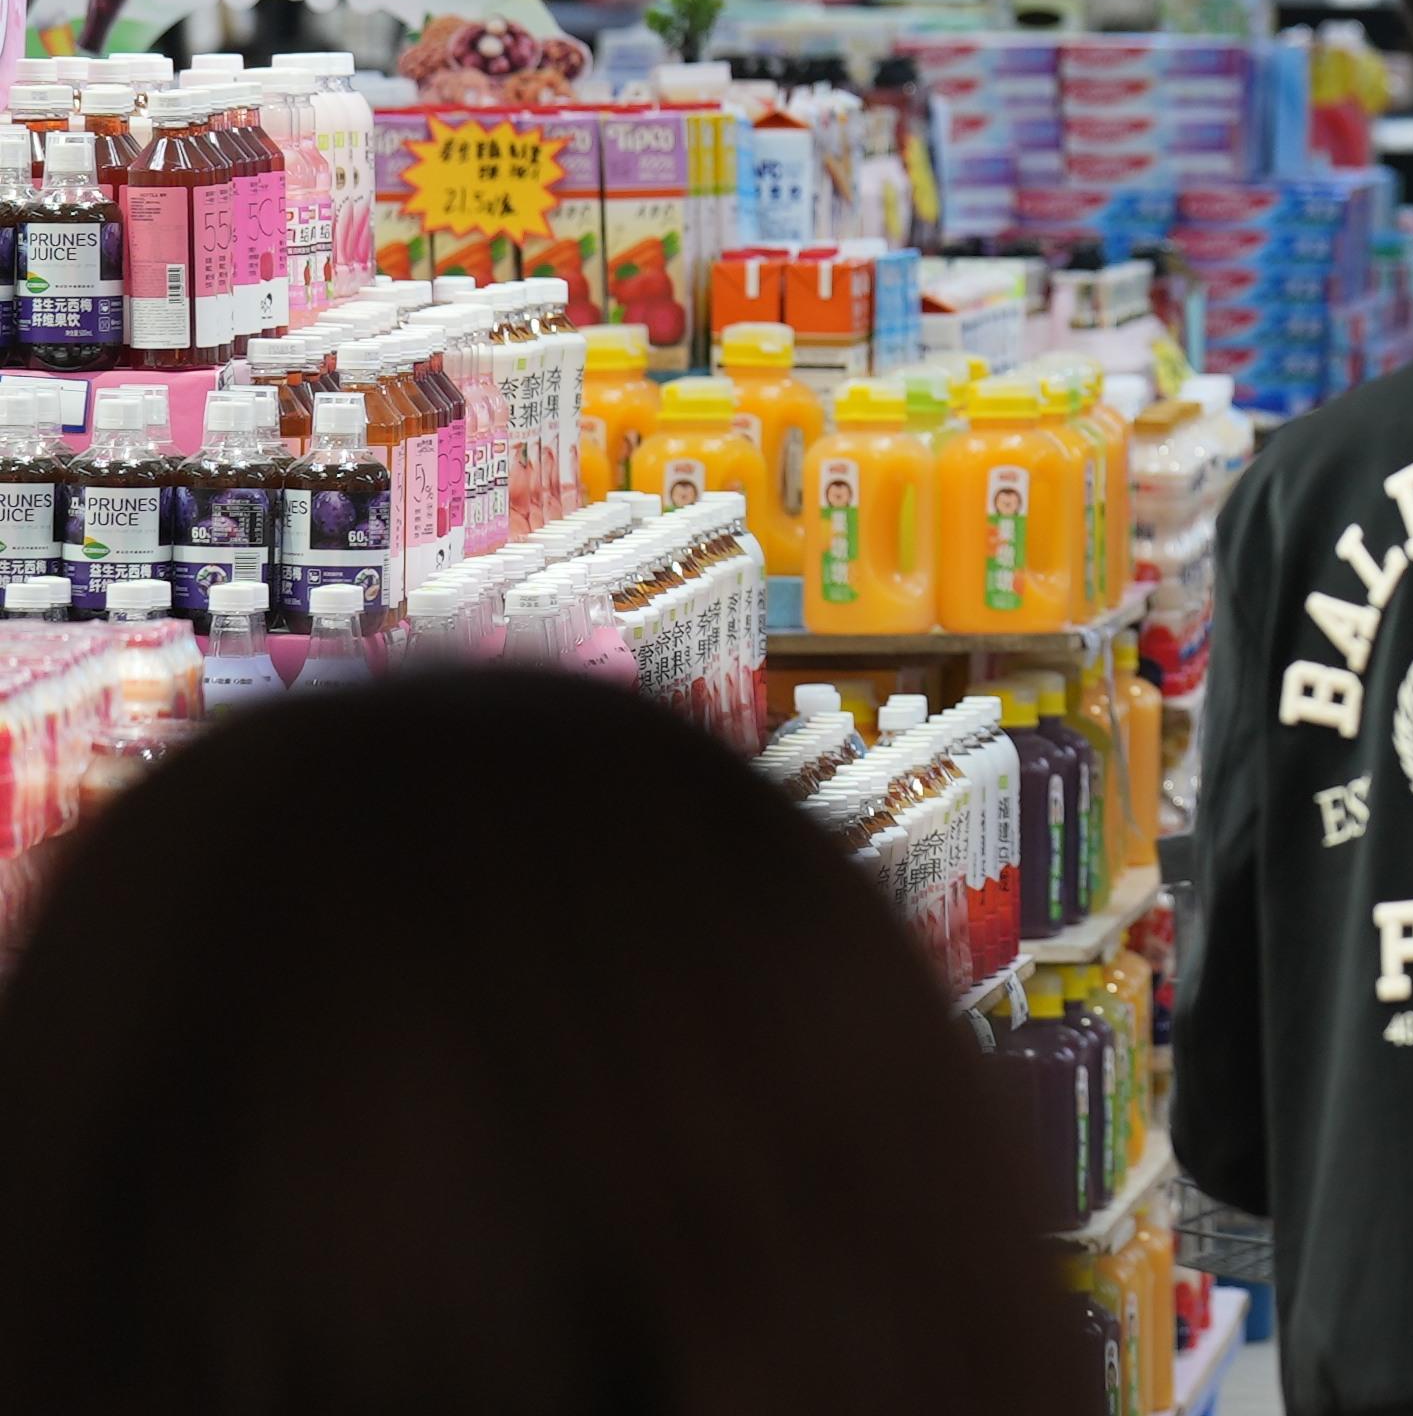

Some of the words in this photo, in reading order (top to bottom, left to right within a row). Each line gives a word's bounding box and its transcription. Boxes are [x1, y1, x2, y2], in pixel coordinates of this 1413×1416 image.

[29, 232, 98, 247] PRUNES
[29, 247, 78, 261] JUICE
[31, 298, 93, 313] 益生元西梅
[31, 312, 81, 328] 纤维果饮
[88, 497, 158, 512] PRUNES
[88, 512, 140, 526] JUICE
[89, 563, 153, 579] 益生元西梅
